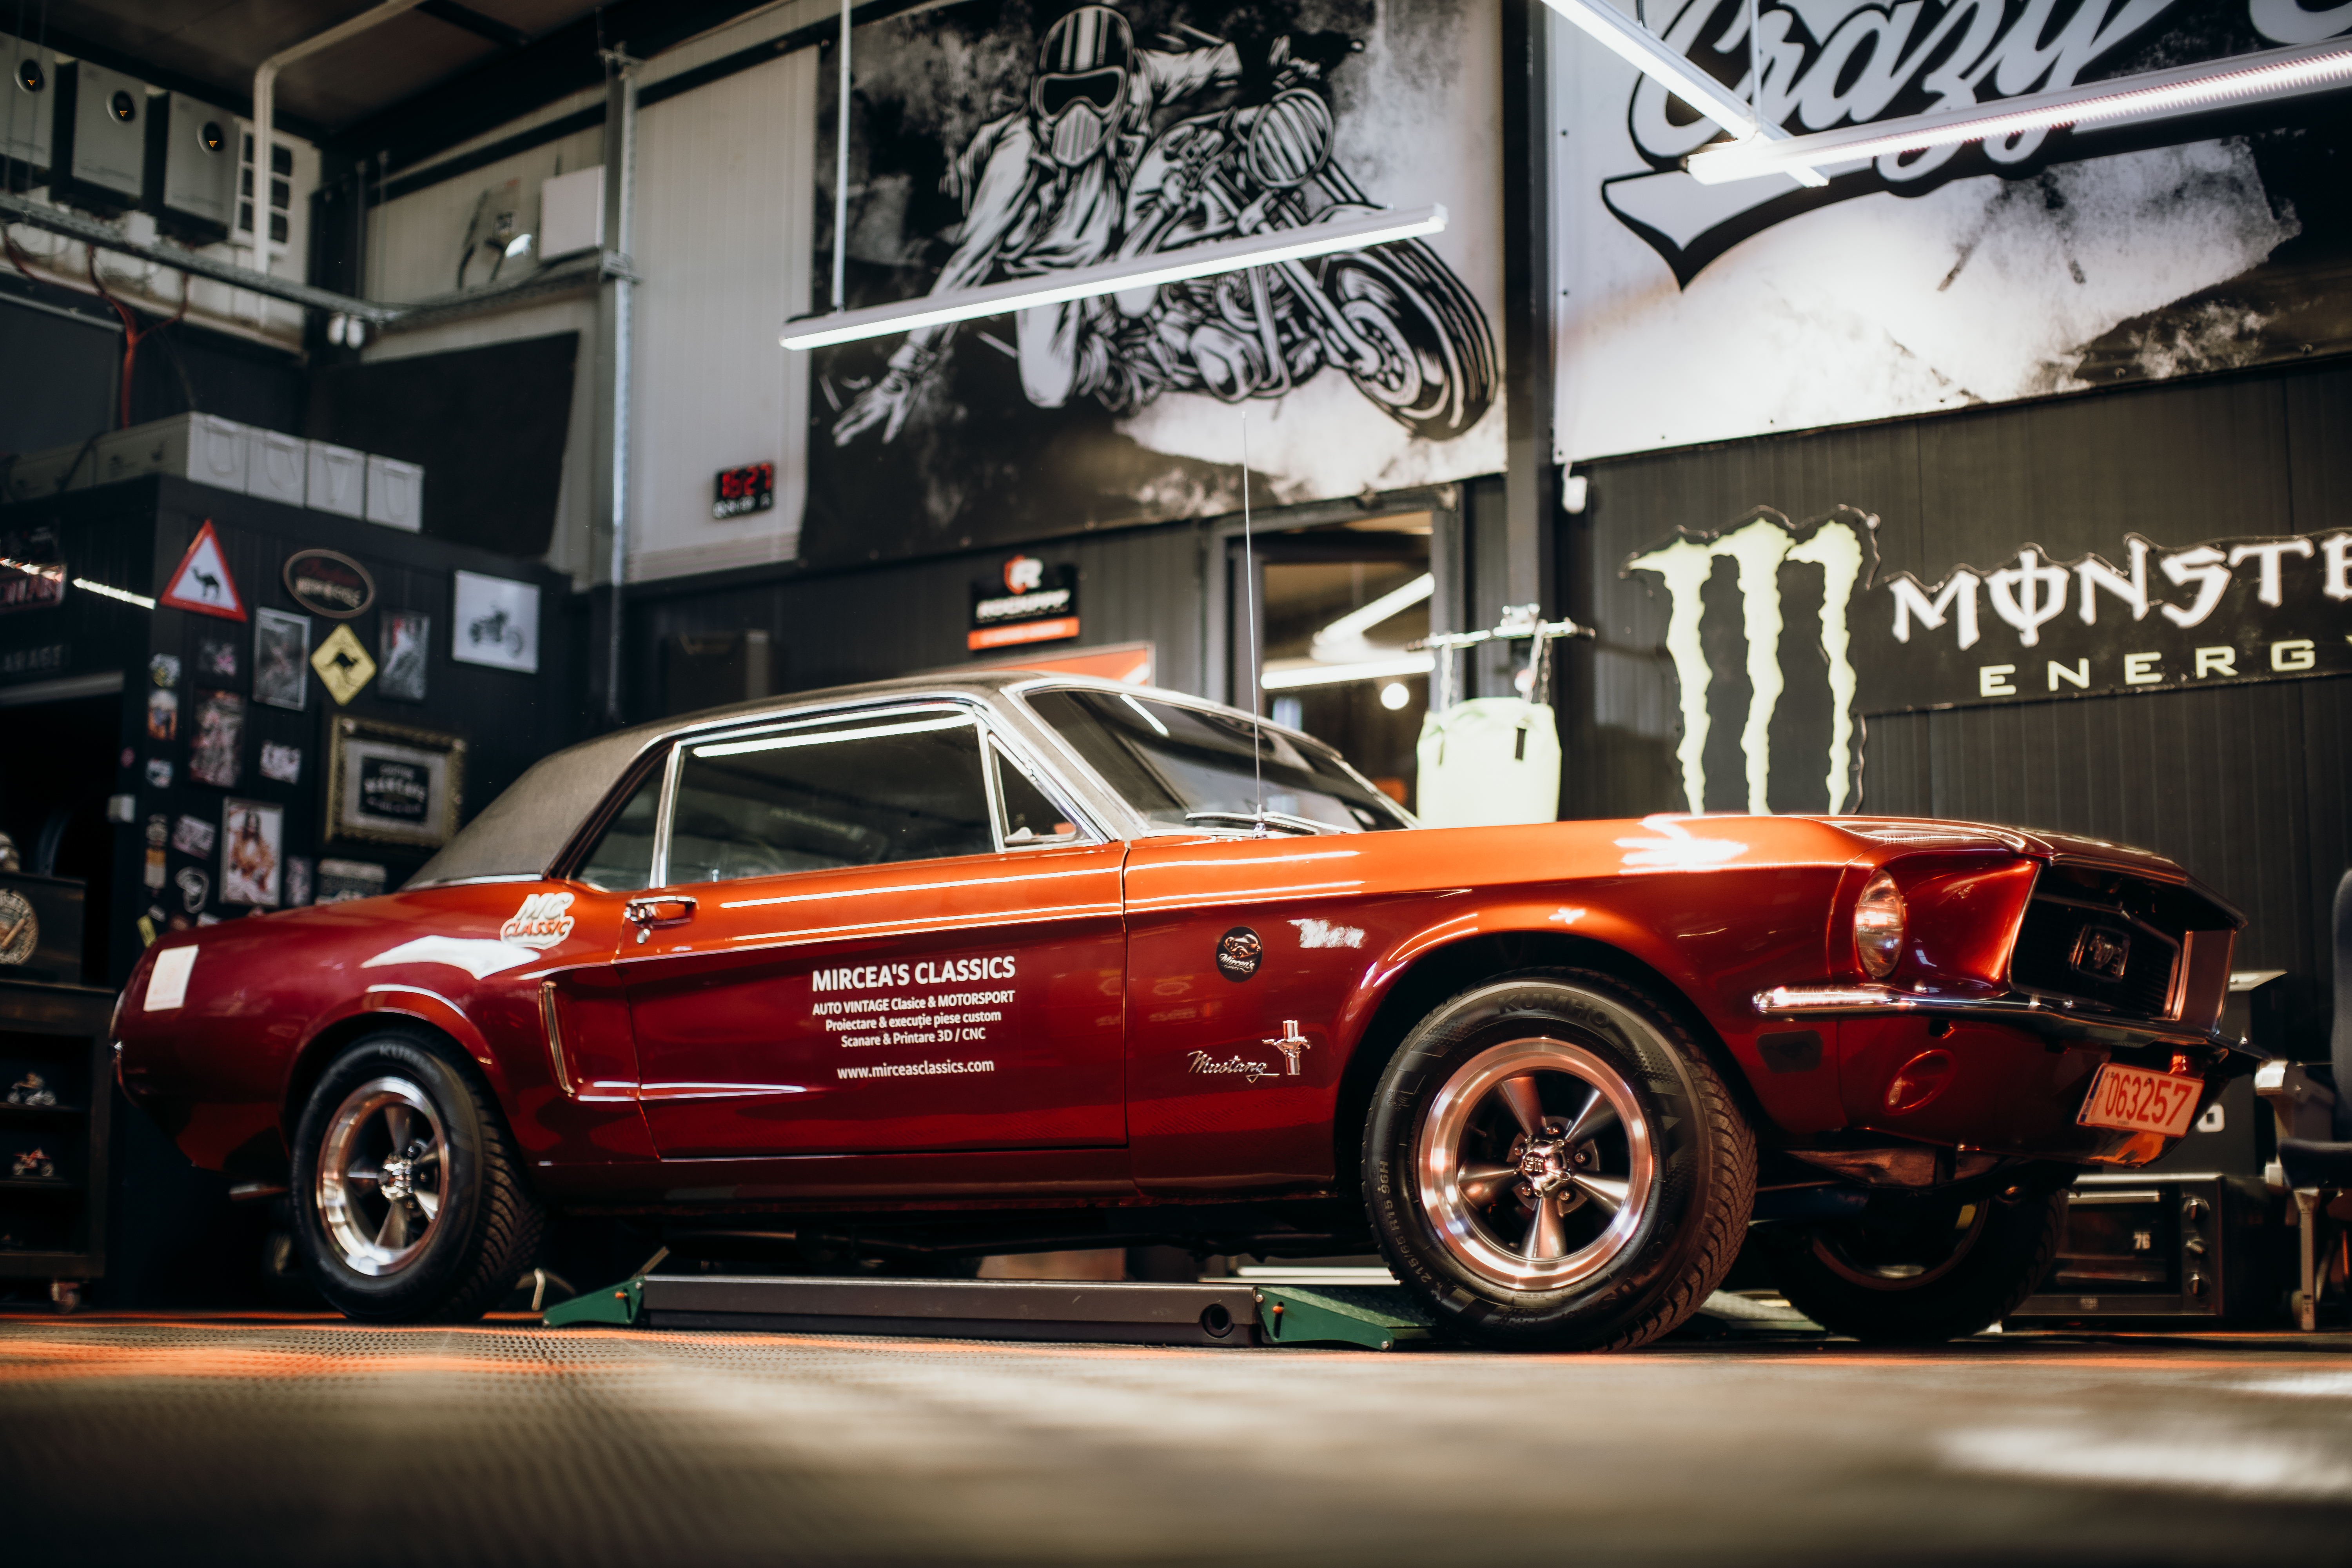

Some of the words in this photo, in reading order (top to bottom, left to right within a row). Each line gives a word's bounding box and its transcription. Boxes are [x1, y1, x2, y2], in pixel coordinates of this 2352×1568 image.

[1980, 634, 2352, 697] ENERG
[517, 893, 572, 920] MC
[503, 919, 571, 937] CLASSIC
[812, 964, 910, 992] MIRCEA'S
[915, 955, 1016, 984] CLASSICS
[1219, 953, 1255, 973] Mircea's
[812, 1001, 842, 1016] AUTO
[843, 998, 890, 1013] VINTAGE
[891, 996, 926, 1011] Clasice
[928, 996, 936, 1007] &
[938, 990, 1015, 1007] MOTORSPORT
[1498, 993, 1613, 1029] KUMHO
[826, 1018, 877, 1032] Proiectare
[879, 1016, 887, 1028] &
[889, 1013, 932, 1030] execuție
[933, 1012, 961, 1028] piese
[962, 1011, 1001, 1023] custom
[841, 1036, 880, 1048] Scanare
[882, 1034, 891, 1045] &
[893, 1031, 935, 1044] Printare
[937, 1029, 953, 1042] 3D
[955, 1028, 960, 1042] /
[962, 1027, 986, 1040] CNC
[837, 1058, 995, 1080] www.mirceasclassics.com
[1187, 1050, 1280, 1083] Mustang
[2106, 1073, 2193, 1127] 063257
[1379, 1160, 1391, 1195] 96H
[1382, 1198, 1401, 1232] R15
[1394, 1232, 1433, 1287] 215/65
